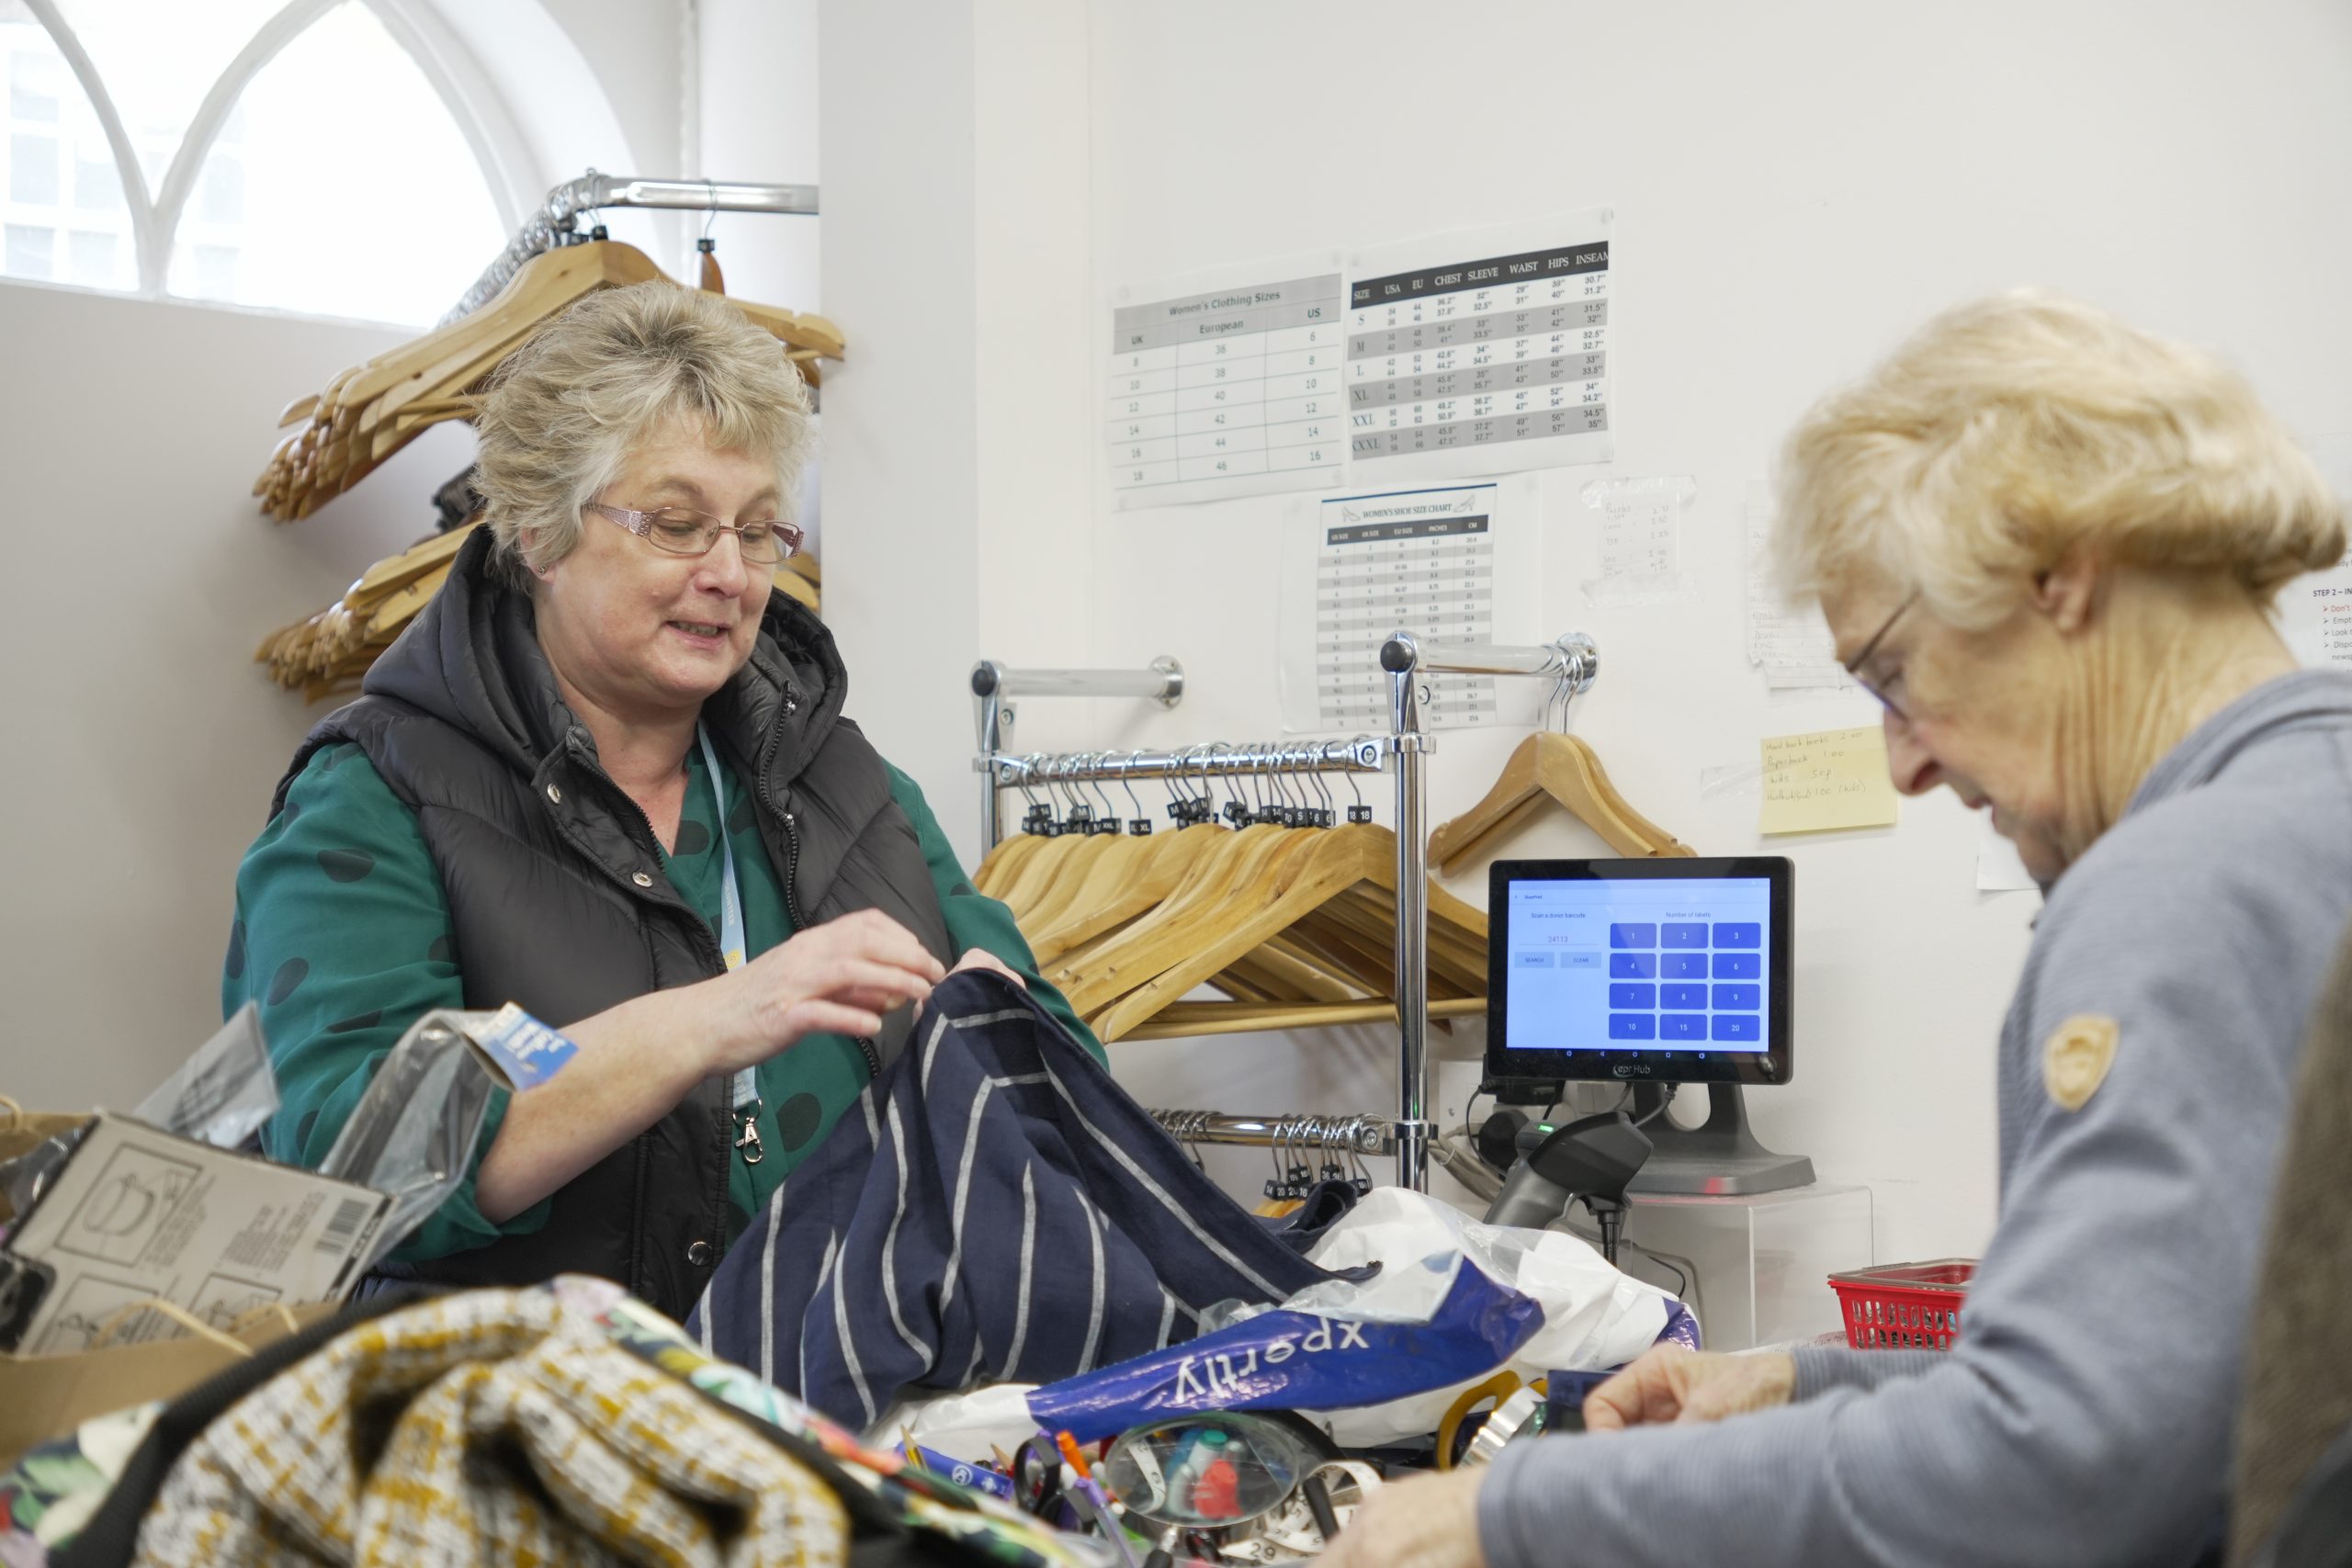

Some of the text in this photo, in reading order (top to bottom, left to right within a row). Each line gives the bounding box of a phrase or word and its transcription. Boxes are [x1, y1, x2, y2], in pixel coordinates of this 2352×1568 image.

[1354, 289, 1370, 299] SIZE
[1385, 284, 1400, 295] USA
[1412, 279, 1423, 289] EU
[1435, 273, 1462, 286] CHEST
[1468, 267, 1498, 280] SLEEVE
[1510, 262, 1538, 274] WAIST
[1548, 257, 1569, 268] HIPS
[1585, 275, 1606, 284] 30.7"
[1169, 291, 1280, 316] Women's Clothing Sizes
[1358, 314, 1364, 325] S
[1585, 285, 1606, 294] 31.2"
[1552, 303, 1605, 316] 41" 31.5"
[1132, 309, 1320, 344] UK European US
[1357, 342, 1364, 353] M
[1552, 319, 1564, 327] 42"
[1588, 314, 1601, 322] 32"
[1584, 330, 1604, 338] 32.5"
[1310, 333, 1315, 341] 6
[1357, 366, 1363, 376] L
[1583, 341, 1603, 349] 32.7"
[1586, 355, 1600, 364] 33"
[1130, 380, 1139, 389] 10
[1354, 389, 1369, 401] XL
[1582, 366, 1602, 375] 33.5"
[1586, 382, 1599, 391] 34"
[1129, 379, 1316, 412] 12 40 10
[1352, 393, 1602, 426] XXL 47" 54" 34.2"
[1584, 408, 1604, 417] 34.5"
[1130, 403, 1316, 435] 14 42 12
[1517, 428, 1529, 436] 51"
[1553, 423, 1565, 432] 57"
[1589, 419, 1601, 428] 35"
[1216, 438, 1226, 446] 44
[1308, 427, 1317, 436] 14
[1216, 461, 1227, 470] 46
[1310, 451, 1320, 460] 16
[1363, 510, 1393, 518] WOMEN'S
[1414, 505, 1427, 513] SIZE
[1429, 504, 1452, 513] CHART
[1350, 810, 1370, 819] 18 18
[1634, 1065, 1651, 1075] Hub
[1173, 1316, 1370, 1404] xpertly
[1250, 1542, 1275, 1560] 29
